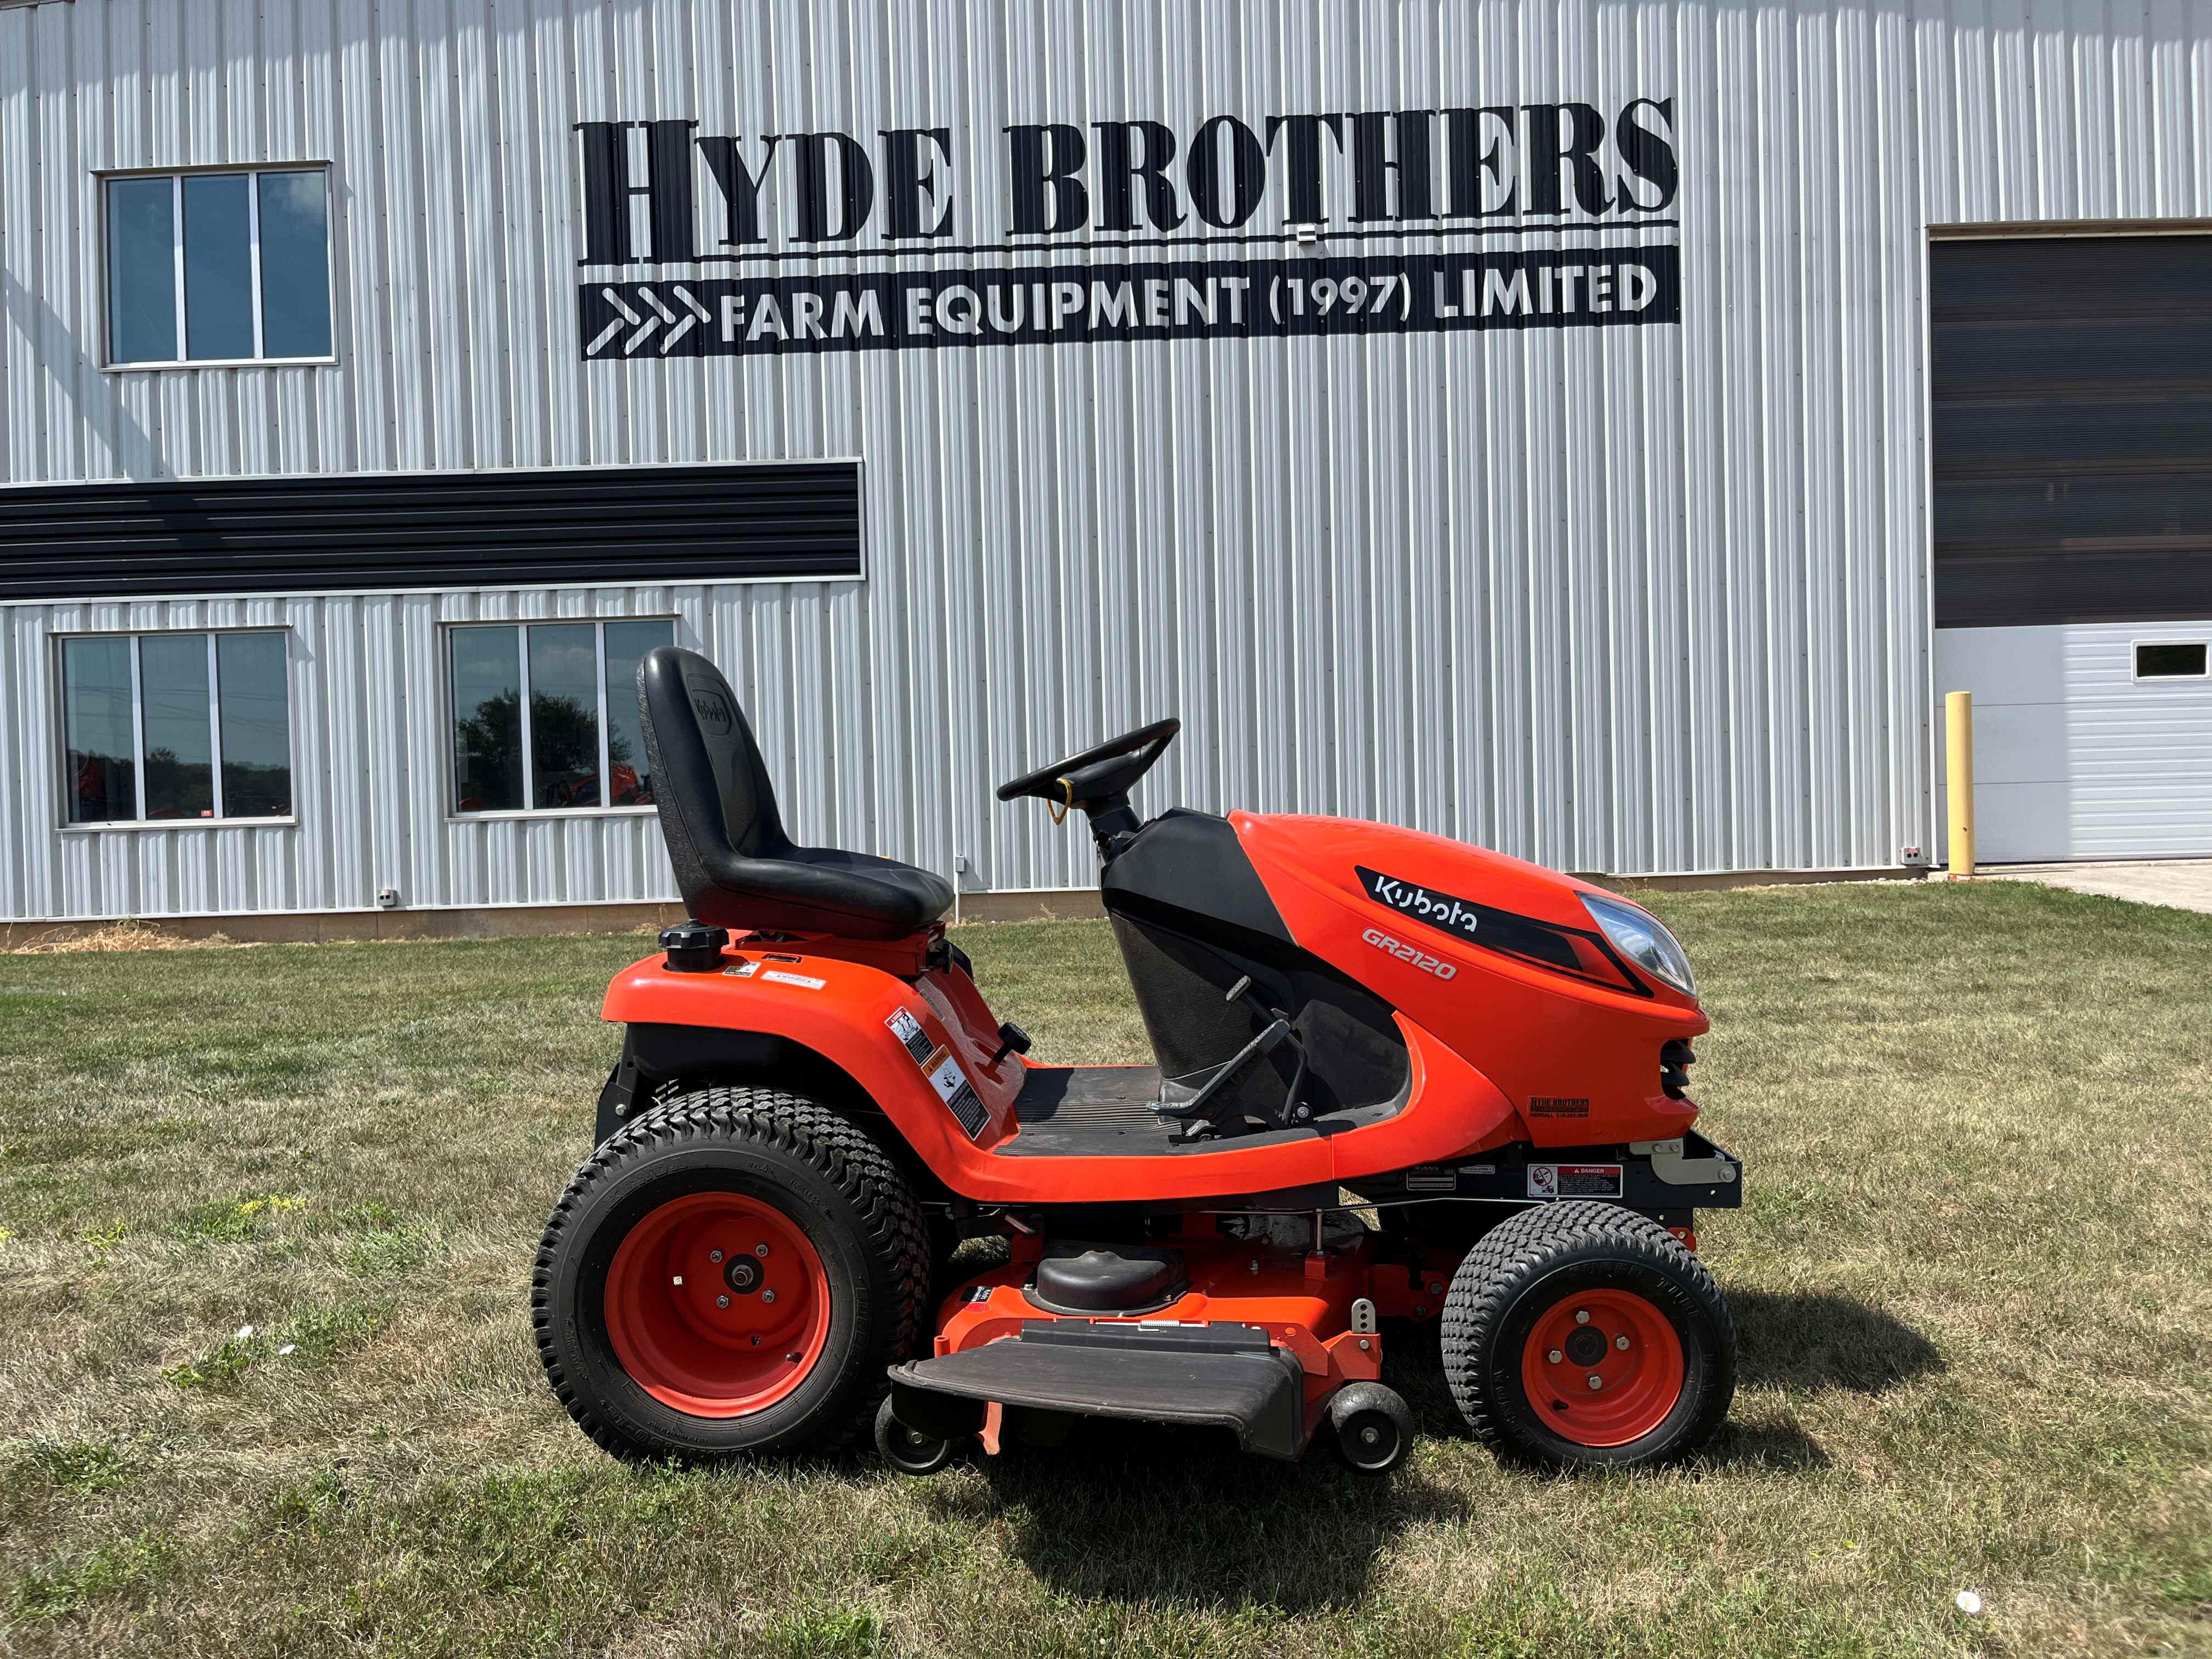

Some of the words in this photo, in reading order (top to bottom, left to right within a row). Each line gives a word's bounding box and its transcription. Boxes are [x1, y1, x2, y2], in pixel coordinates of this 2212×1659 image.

[573, 119, 952, 267] HYDE
[1002, 97, 1679, 236] BROTHERS
[720, 289, 884, 342] FARM
[906, 276, 1250, 336] EQUIPMENT
[1269, 272, 1411, 325] (1997)
[1434, 264, 1657, 320] LIMITED
[1375, 876, 1477, 932] Kubota
[1362, 928, 1457, 980] GR2120
[1553, 1098, 1589, 1107] BROTHERS
